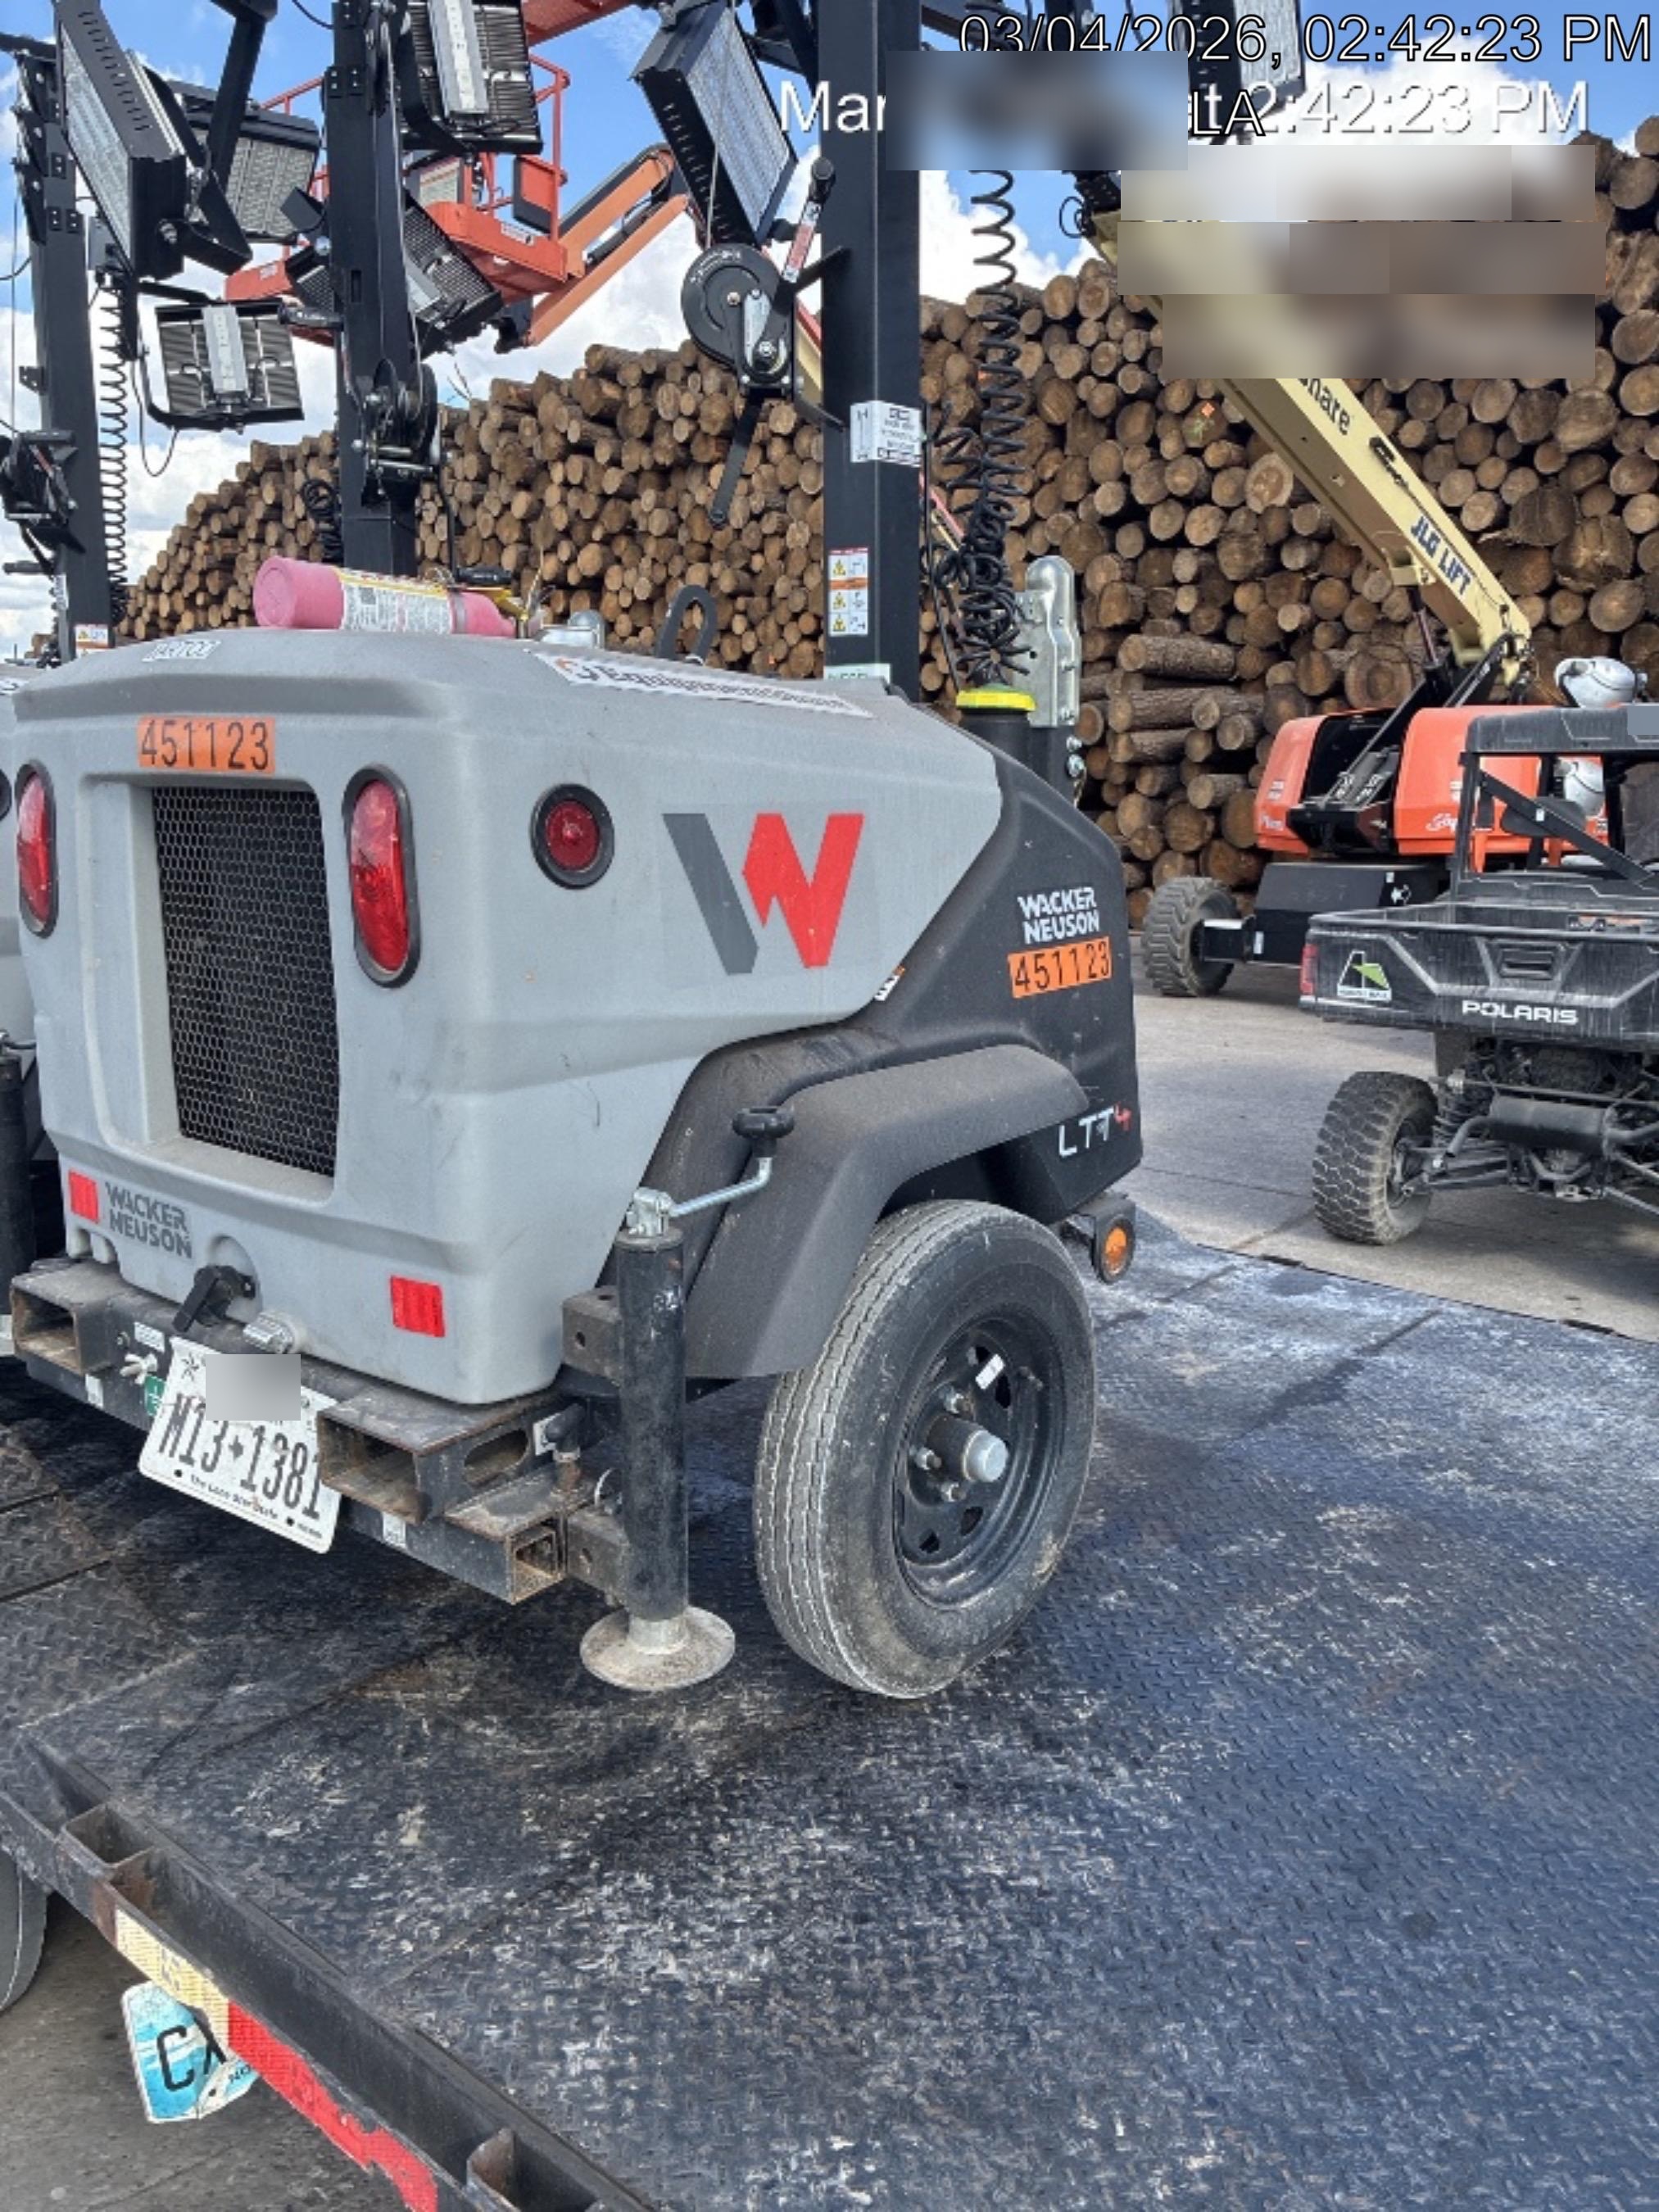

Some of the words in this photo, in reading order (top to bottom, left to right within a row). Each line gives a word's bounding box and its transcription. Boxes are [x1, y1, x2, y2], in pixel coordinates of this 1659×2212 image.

[142, 718, 269, 770] 451123
[1017, 886, 1097, 919] WACKER
[1022, 909, 1100, 945] NEUSON
[1014, 941, 1109, 993] 451123
[1462, 999, 1579, 1025] POLARIS
[105, 1181, 187, 1233] WACKER
[109, 1208, 193, 1259] NEUSON
